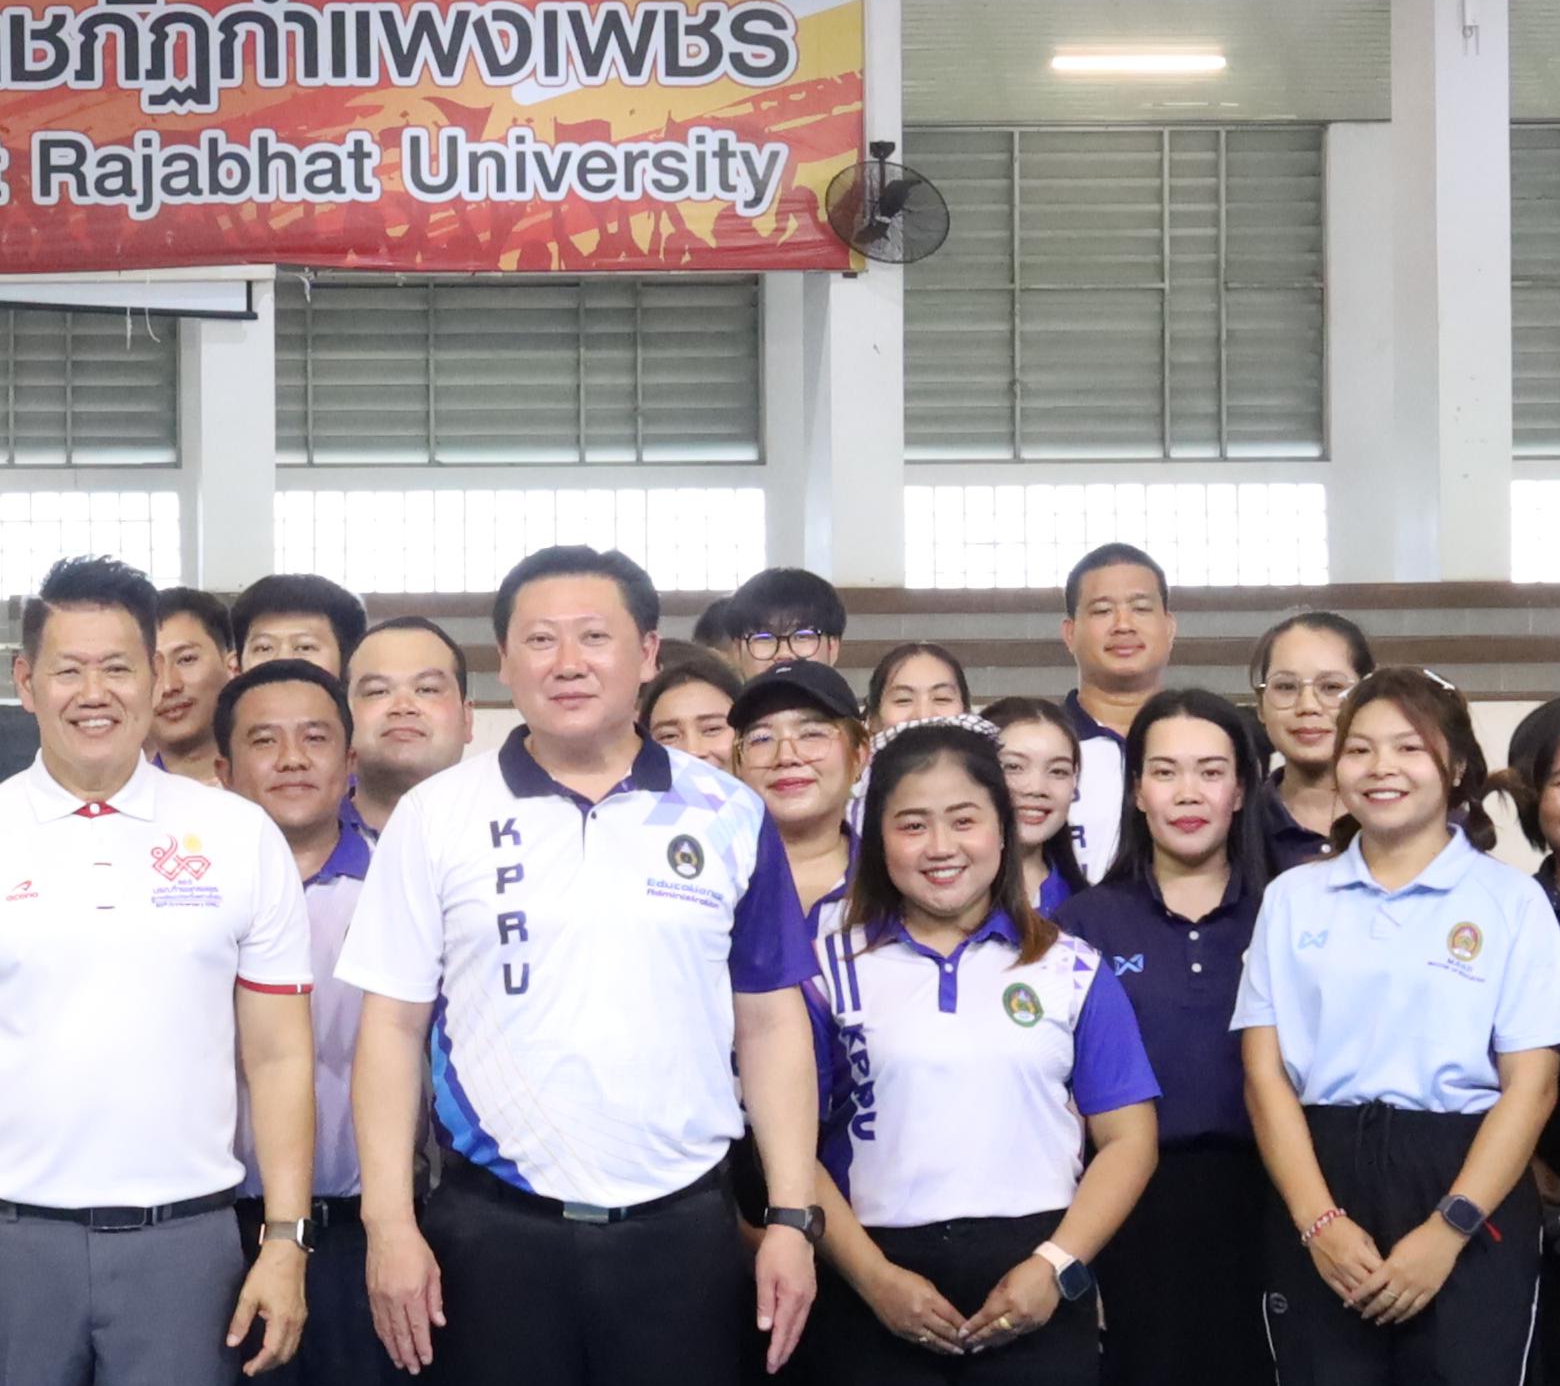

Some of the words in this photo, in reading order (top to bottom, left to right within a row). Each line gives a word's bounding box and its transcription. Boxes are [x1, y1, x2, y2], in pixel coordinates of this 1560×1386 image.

[39, 136, 377, 213] Rajabhat
[409, 133, 783, 209] University
[489, 817, 530, 995] KPRU
